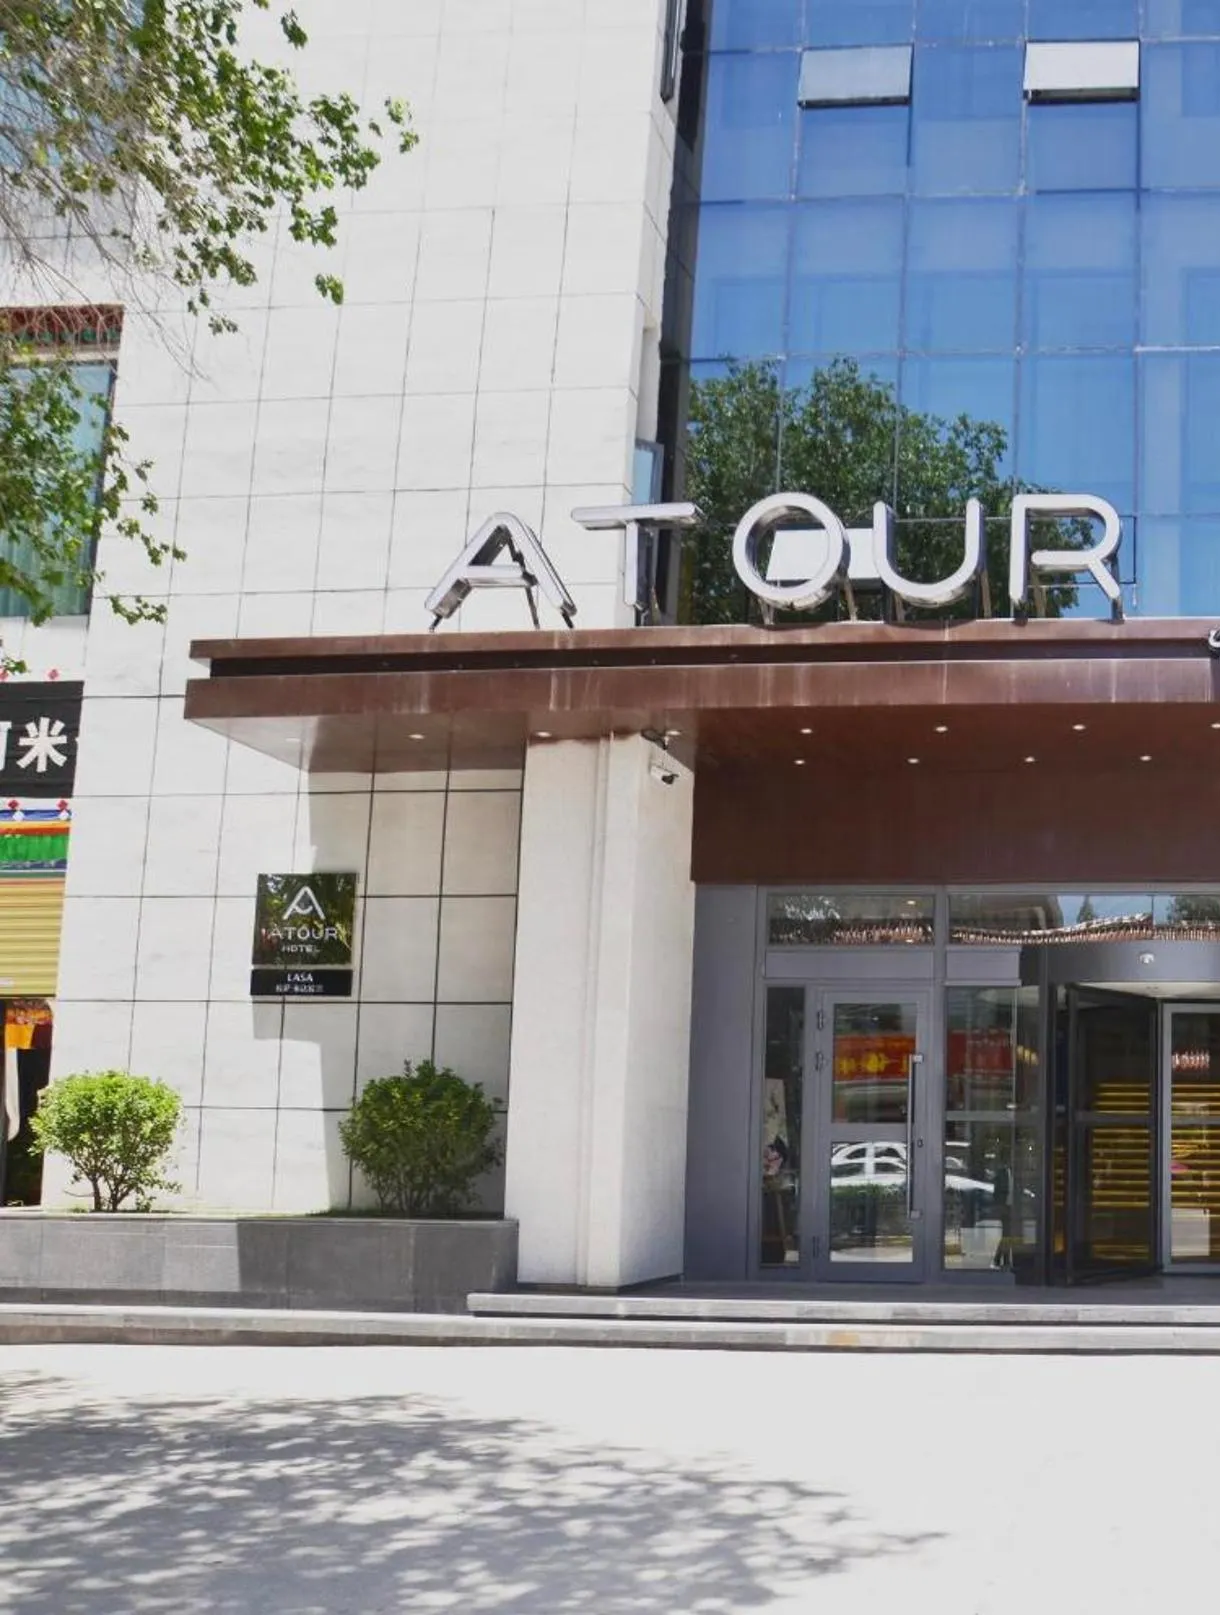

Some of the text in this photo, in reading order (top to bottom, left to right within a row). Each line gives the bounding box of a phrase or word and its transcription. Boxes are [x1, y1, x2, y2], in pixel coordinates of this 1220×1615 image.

[424, 492, 1123, 617] ATOUR
[270, 926, 338, 940] ATOUR
[282, 944, 320, 953] HOTEL
[287, 973, 314, 982] LASA
